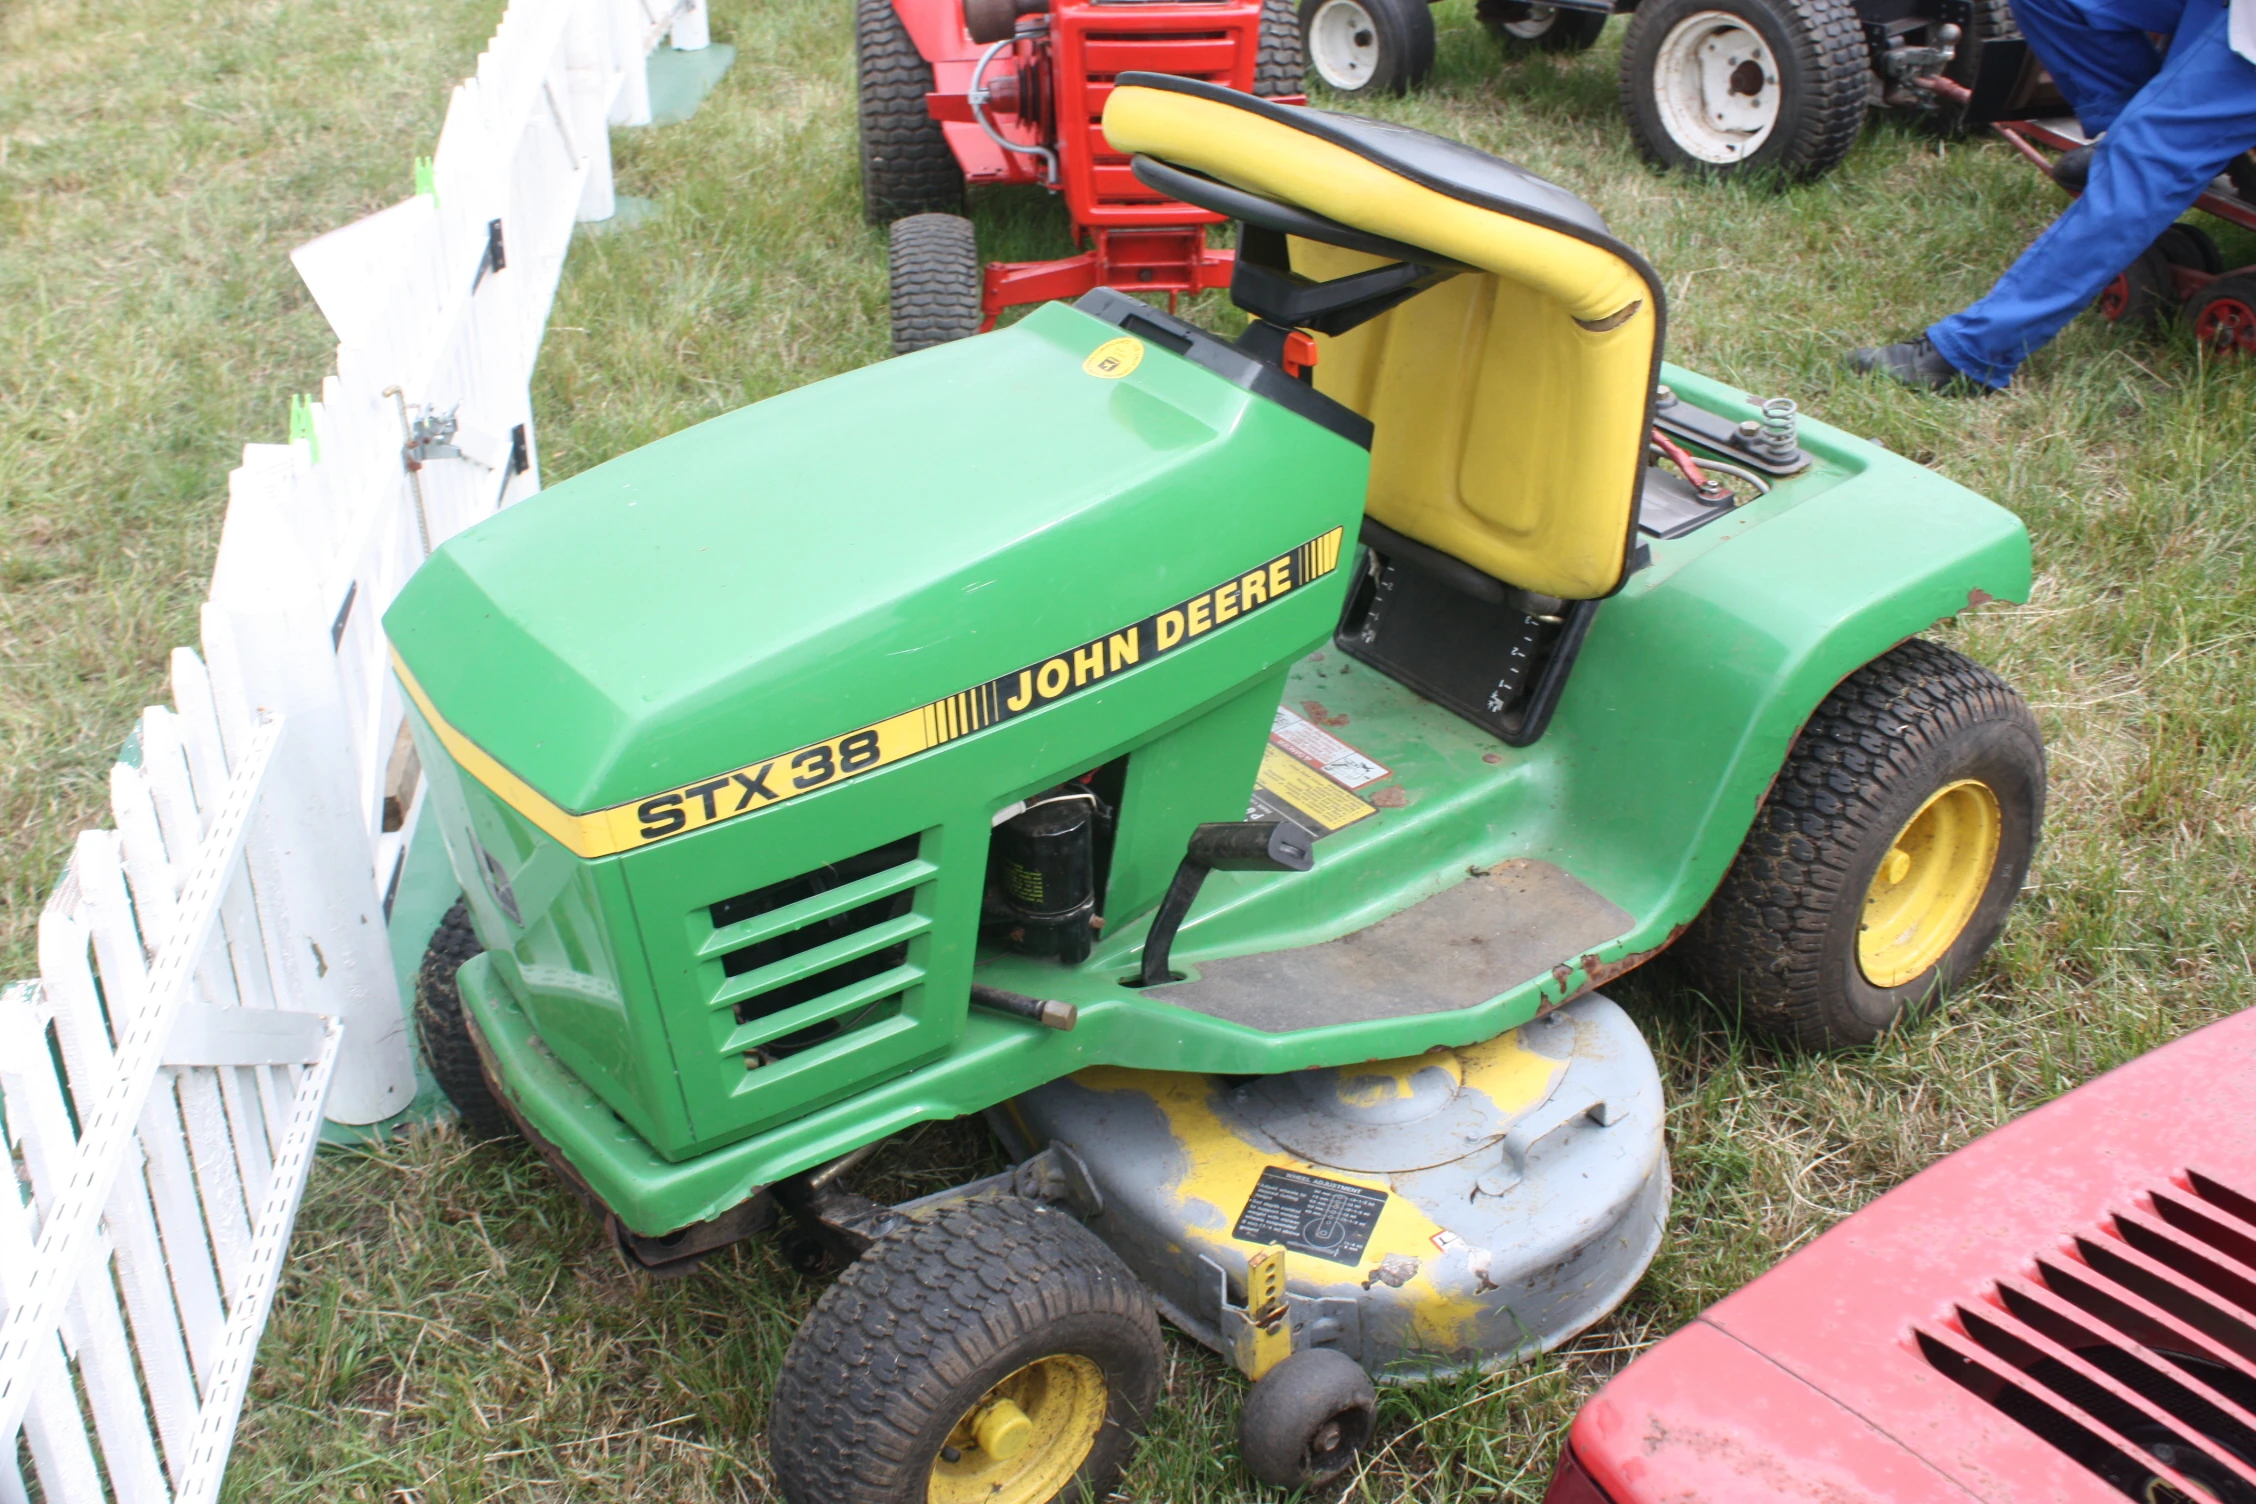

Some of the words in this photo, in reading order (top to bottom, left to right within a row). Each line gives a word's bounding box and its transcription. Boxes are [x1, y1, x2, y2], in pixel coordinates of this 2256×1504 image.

[637, 762, 780, 840] STX
[791, 729, 881, 790] 38
[1006, 626, 1139, 713] JOHN
[1156, 555, 1292, 652] DEERE
[1285, 1173, 1311, 1182] WHEEL
[1312, 1179, 1362, 1194] ADJUSTMENT
